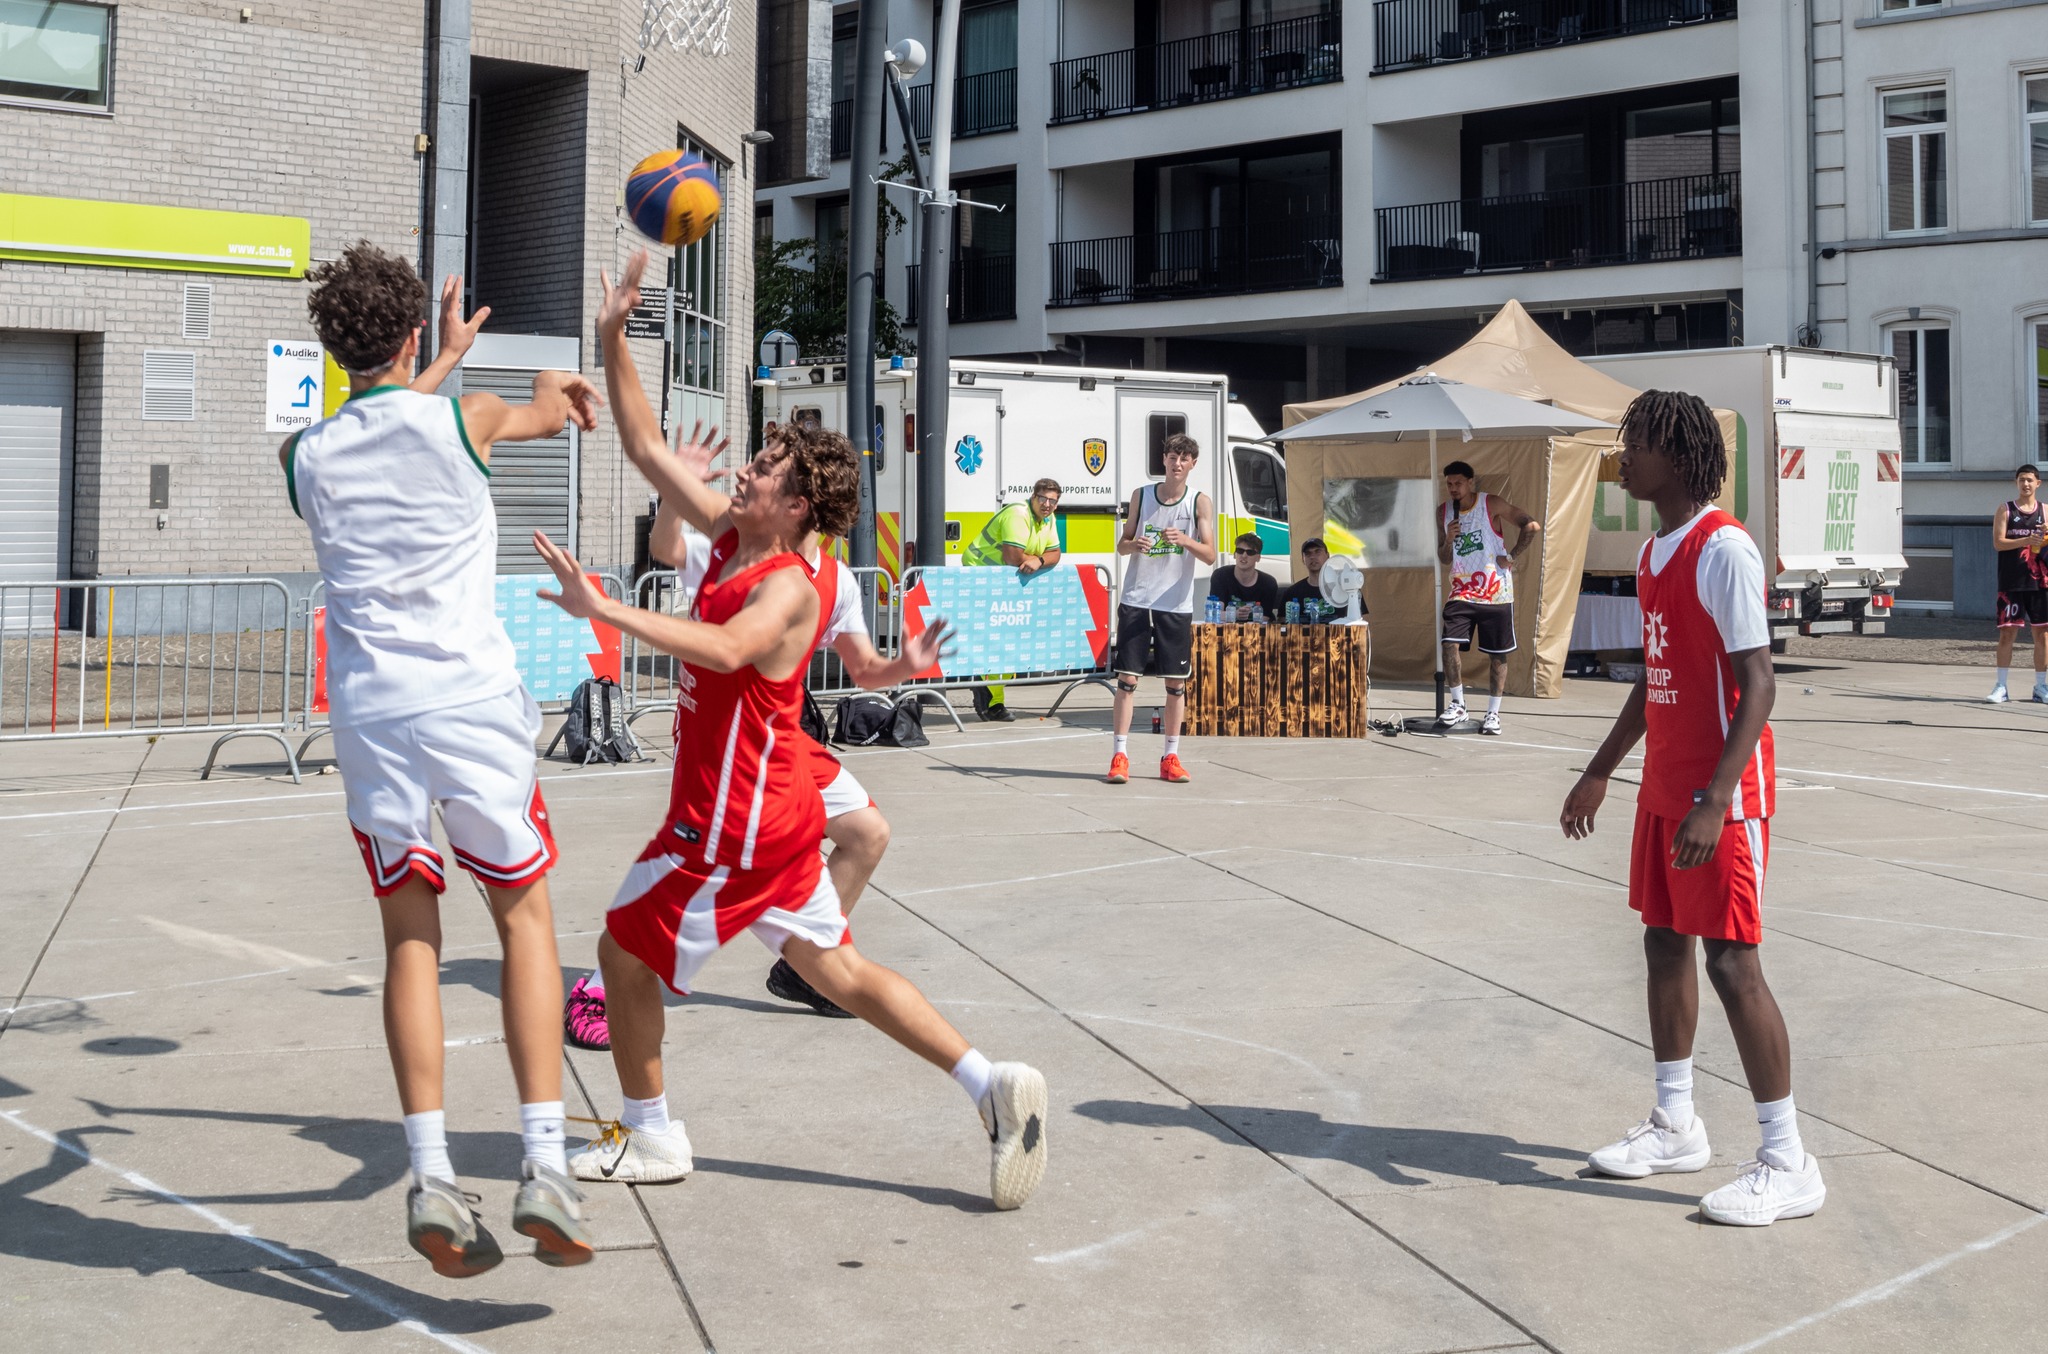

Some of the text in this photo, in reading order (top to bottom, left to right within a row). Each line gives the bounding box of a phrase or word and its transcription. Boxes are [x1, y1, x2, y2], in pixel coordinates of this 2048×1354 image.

[228, 243, 292, 258] www.cm.be
[285, 348, 319, 358] Audika
[276, 414, 312, 426] Ingang
[1828, 462, 1860, 490] YOUR
[1061, 486, 1090, 494] UPPORT
[1826, 493, 1858, 521] NEXT
[1824, 523, 1856, 551] MOVE
[990, 600, 1033, 613] AALST
[2005, 603, 2019, 618] 10
[989, 614, 1032, 627] SPORT
